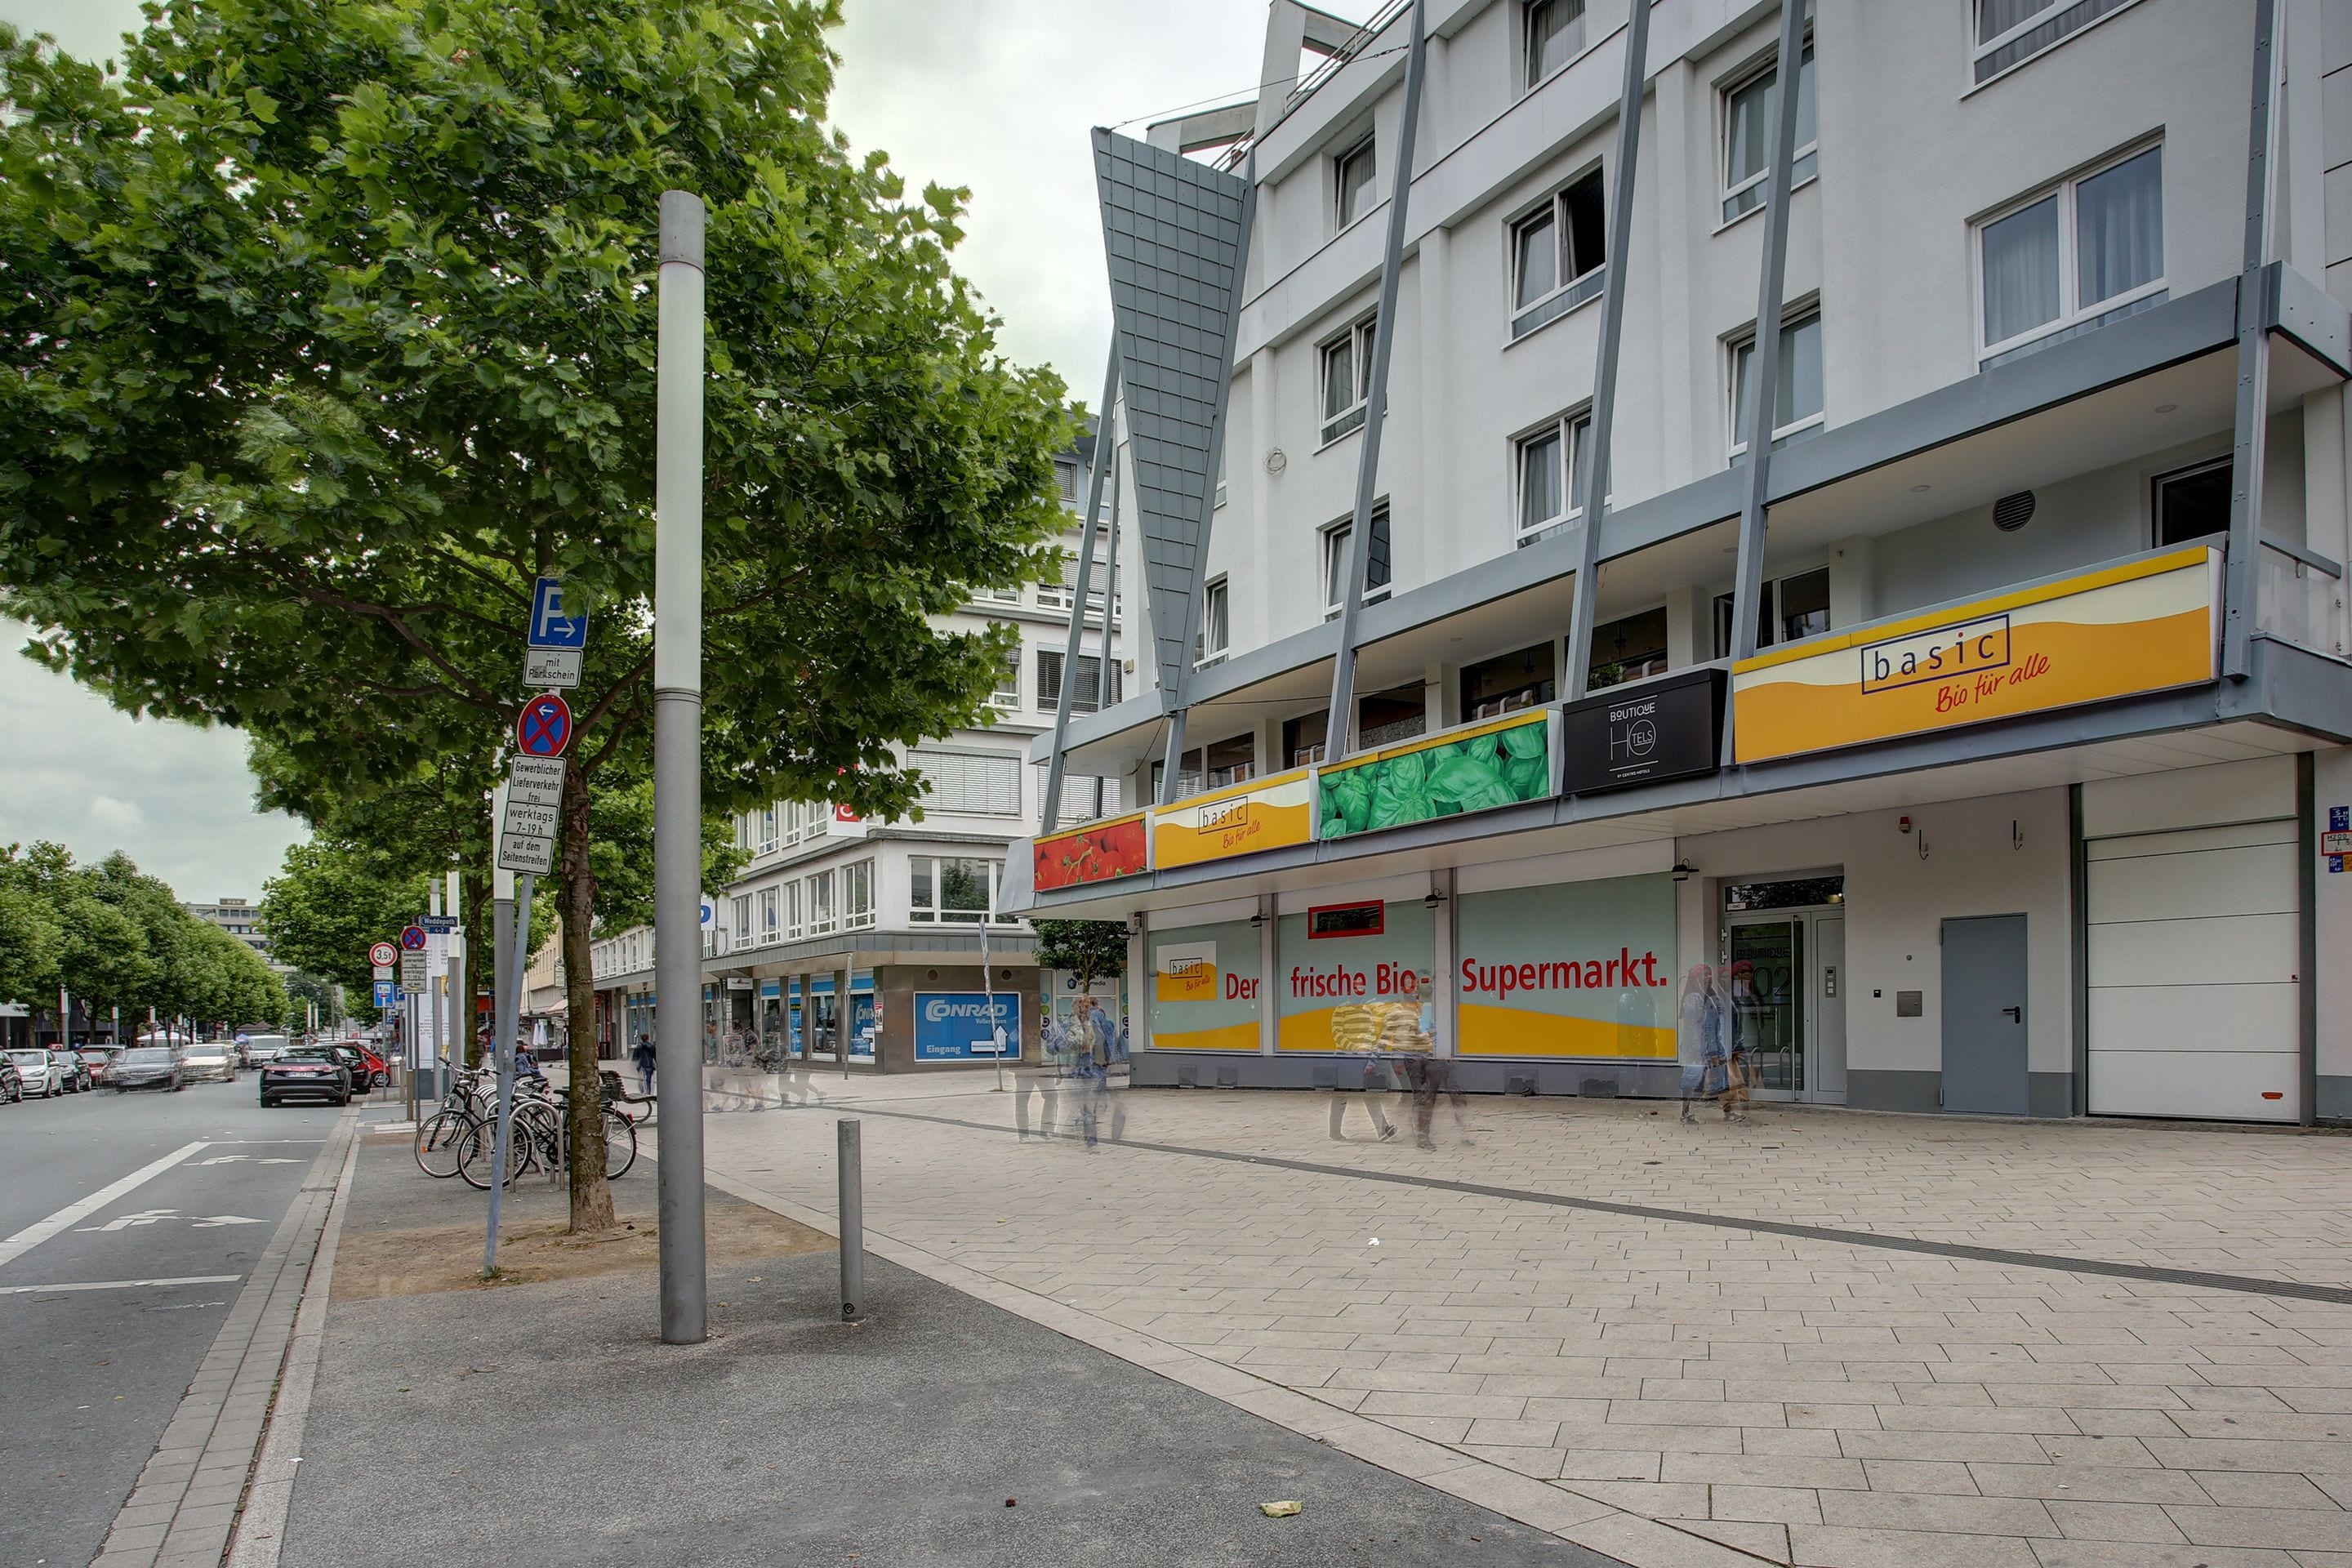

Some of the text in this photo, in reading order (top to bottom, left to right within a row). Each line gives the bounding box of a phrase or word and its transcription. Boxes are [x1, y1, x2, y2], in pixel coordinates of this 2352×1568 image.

[546, 658, 560, 667] mit
[1874, 631, 1994, 682] basic
[528, 668, 575, 679] Parkschein
[1935, 653, 2051, 713] Bio für alle
[1610, 702, 1656, 722] BOUTIQUE
[515, 761, 562, 776] Gewerblicher
[512, 776, 559, 791] Lieferverkehr
[528, 792, 541, 804] frei
[510, 809, 554, 824] werktags
[1202, 804, 1243, 828] basic
[539, 826, 543, 835] h
[1223, 819, 1262, 849] Bio für alle
[513, 840, 541, 852] auf dem
[502, 850, 548, 866] Seitenstreifen
[1172, 961, 1200, 975] basic
[1226, 947, 1668, 1000] Der frische Bio- Supermarkt.
[925, 999, 1008, 1022] CONRAD
[926, 1045, 961, 1055] Eingang
